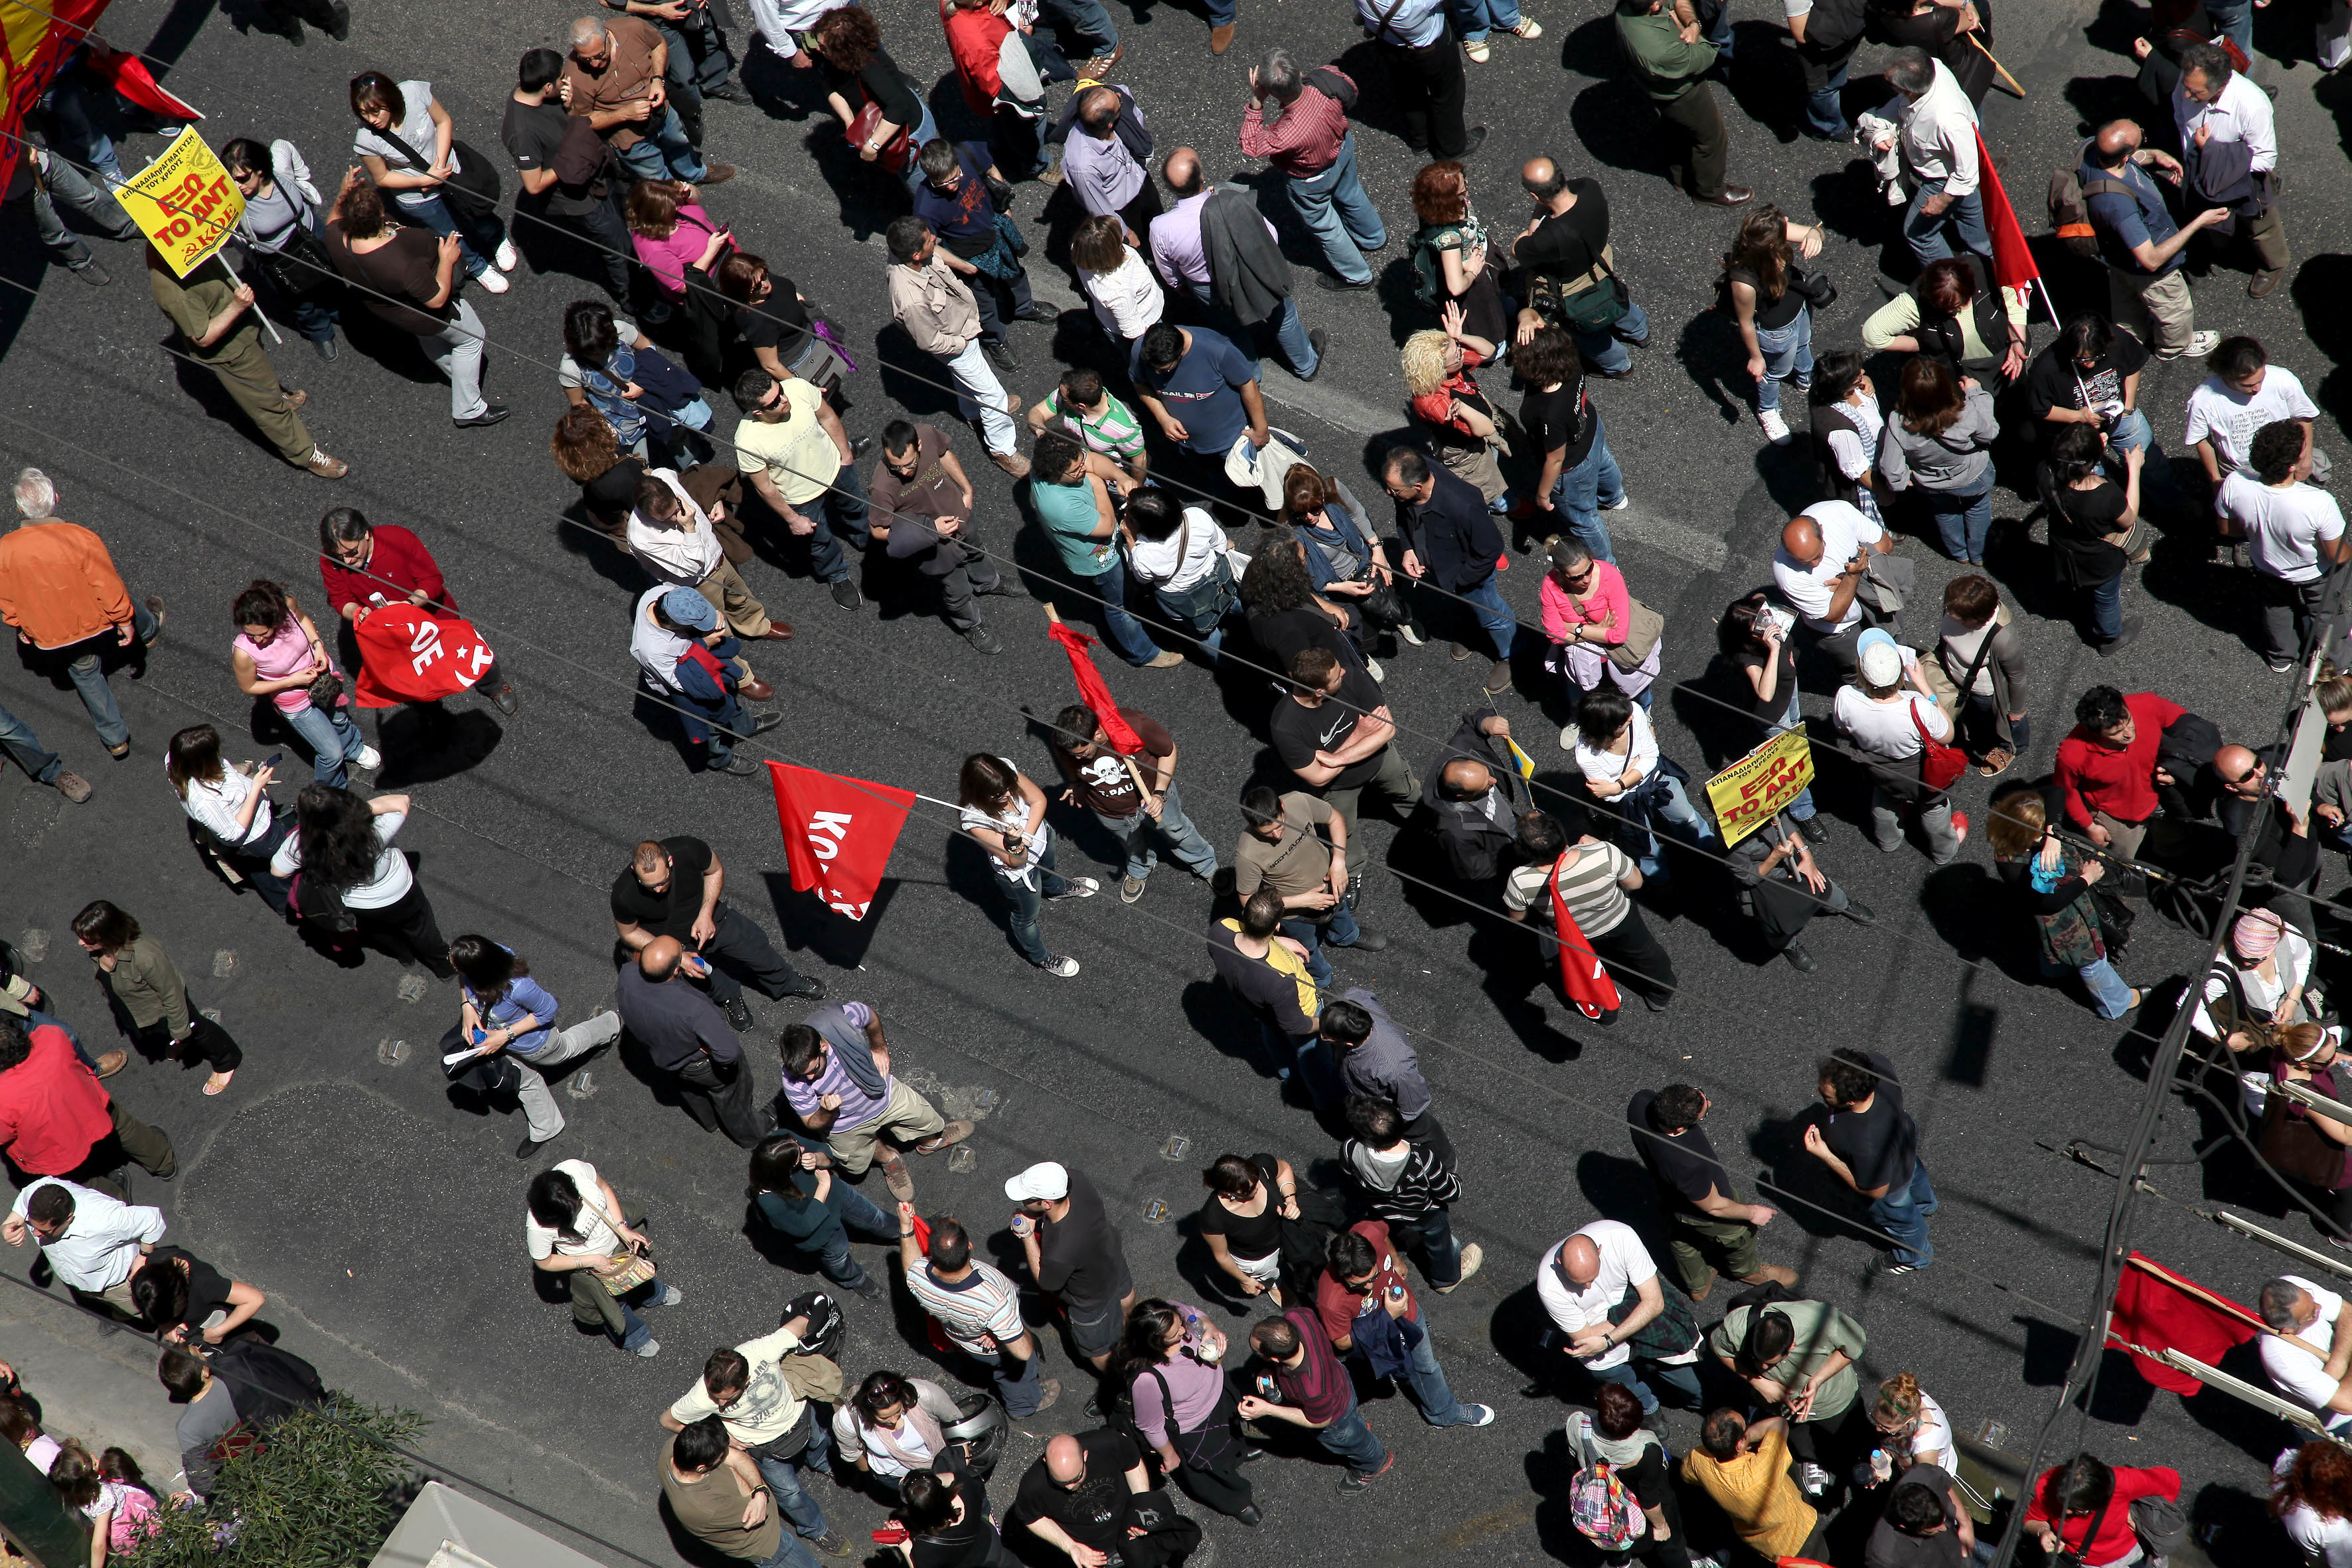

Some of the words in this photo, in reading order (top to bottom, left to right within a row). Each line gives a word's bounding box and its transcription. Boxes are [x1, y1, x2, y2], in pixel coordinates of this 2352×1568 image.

[145, 179, 160, 191] ΤΟΥ
[160, 159, 184, 182] ΧΡΕΟΥΣ
[156, 173, 206, 218] ΕΞΩ
[153, 218, 191, 248] ΤΟ
[196, 203, 237, 248] ΚΟΕ
[1711, 728, 1800, 787] ΕΠΑΝΑΔΙΑΠΡΑΓΜΑΤΕΥΗ
[1737, 769, 1752, 779] ΤΟΥ
[1754, 747, 1780, 769] ΧΡΕΟΥΣ
[1740, 757, 1788, 800] ΕΞΩ
[1723, 799, 1760, 823] ΤΟ
